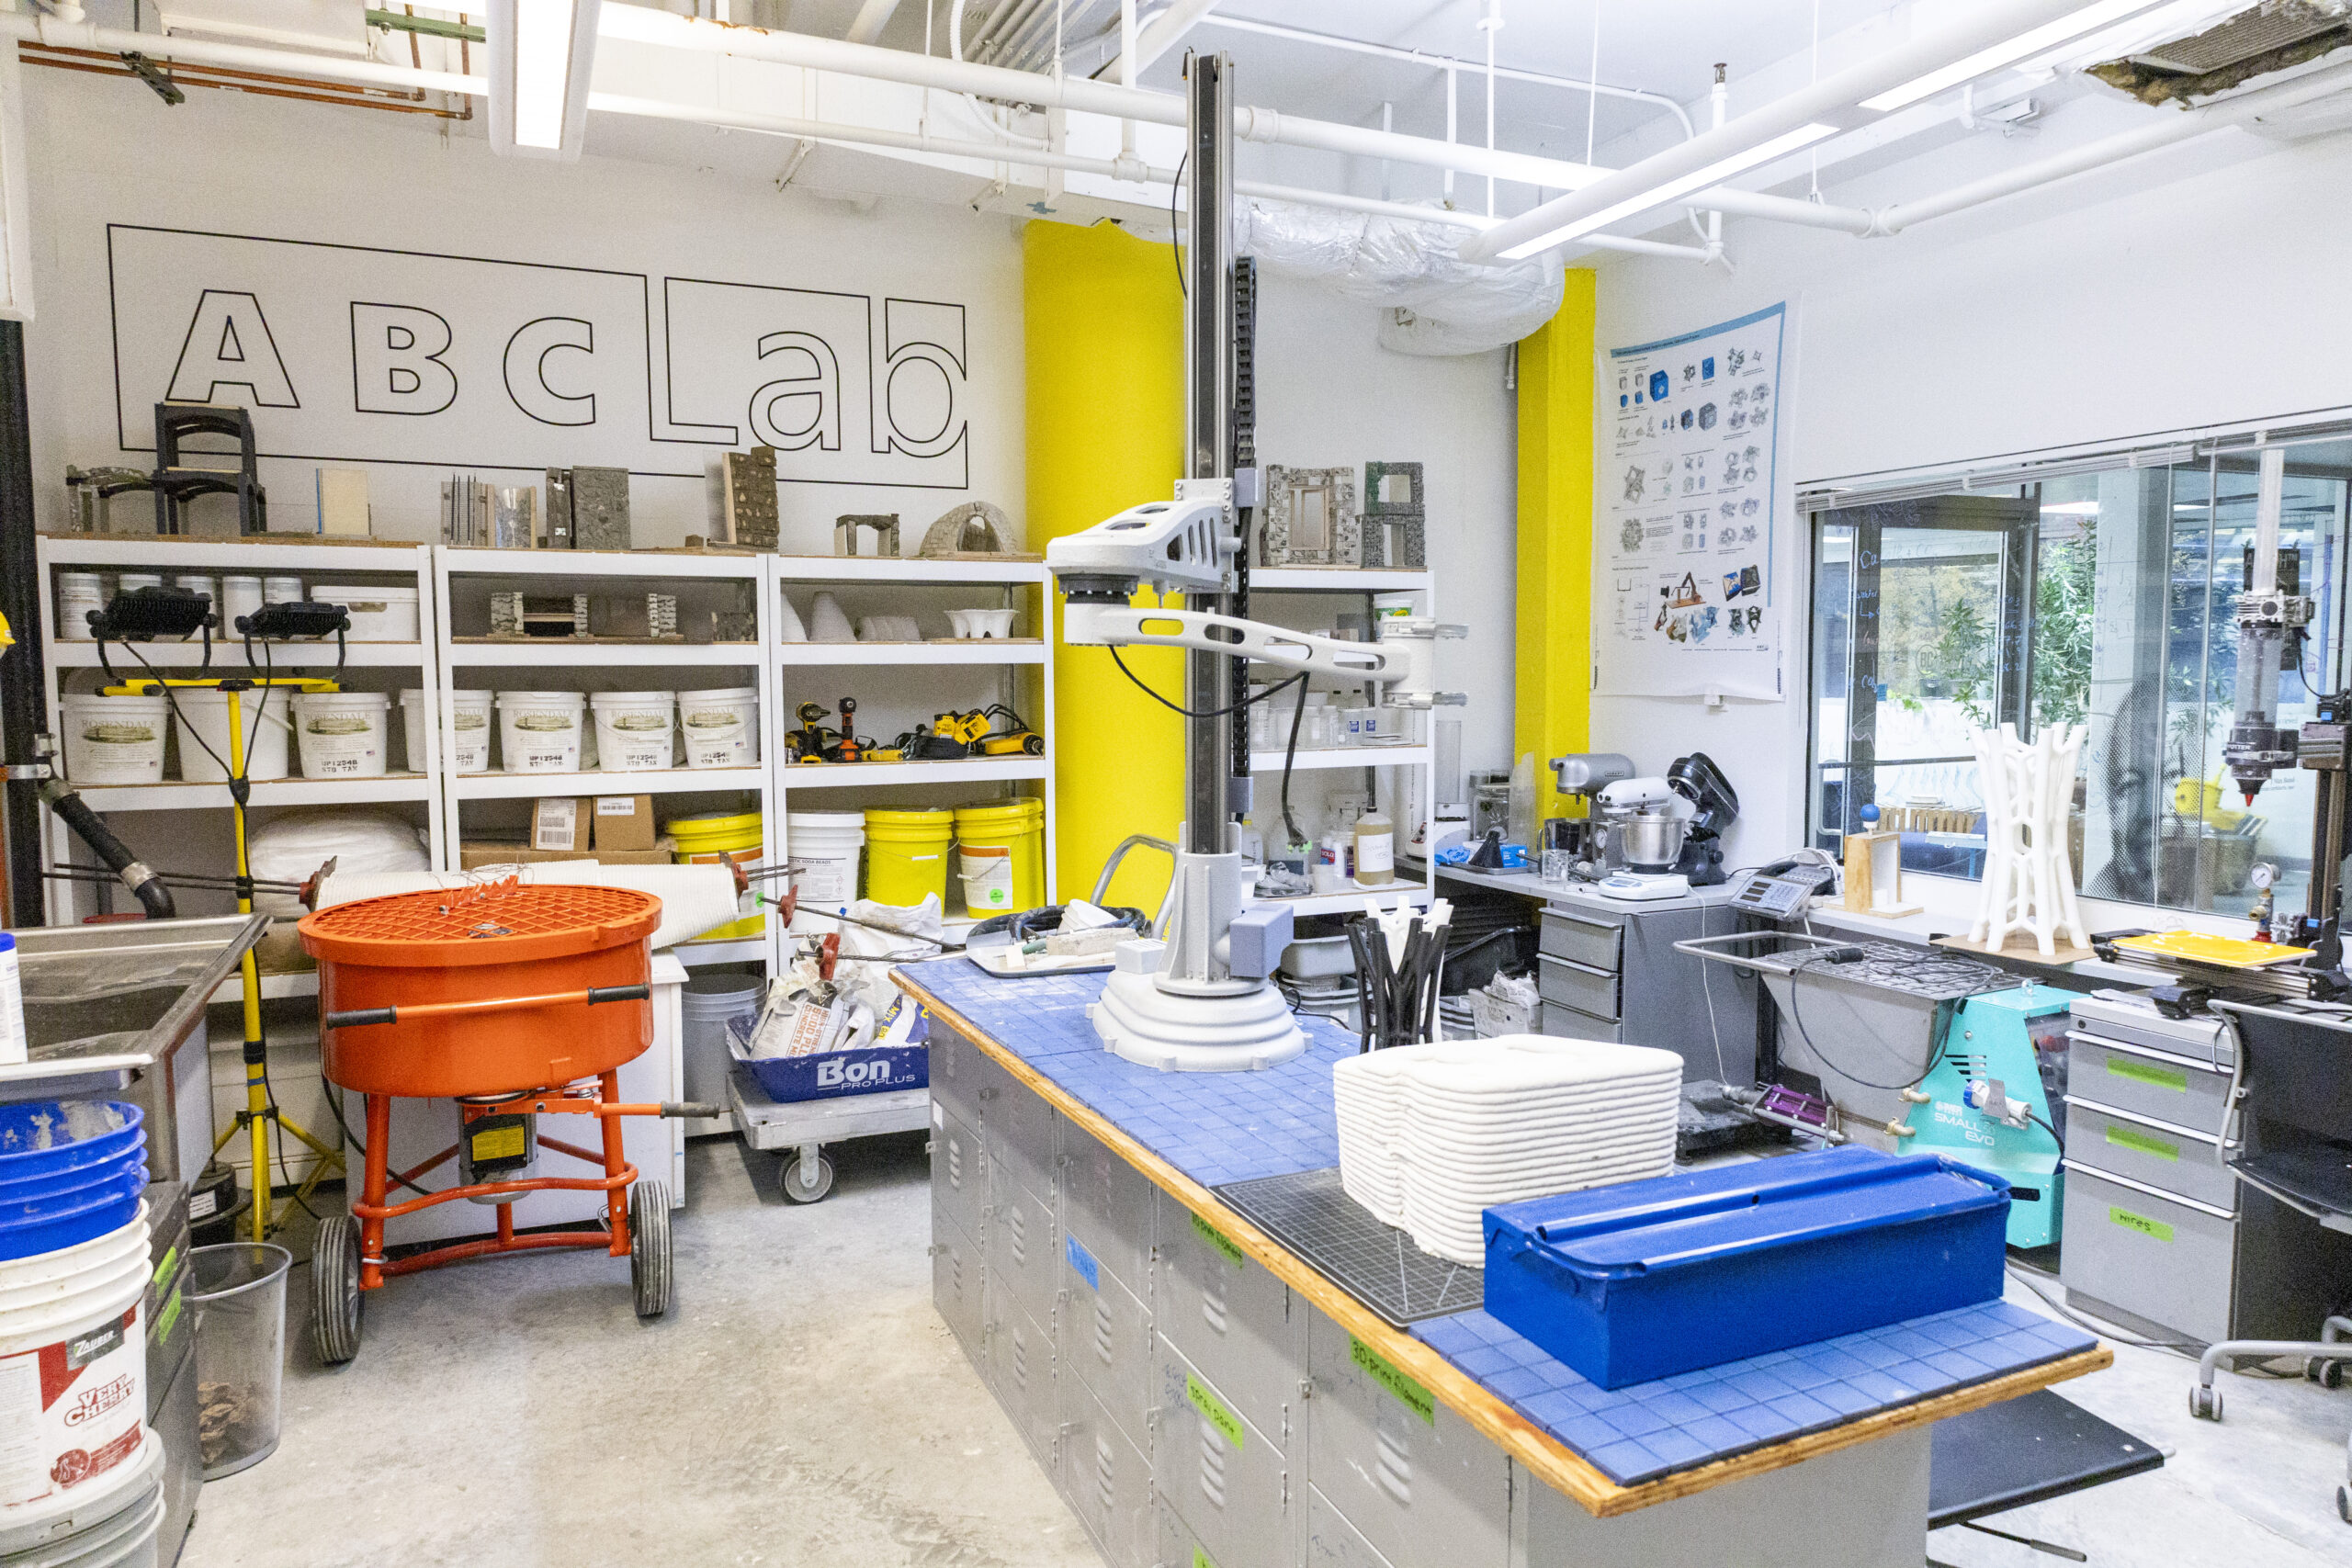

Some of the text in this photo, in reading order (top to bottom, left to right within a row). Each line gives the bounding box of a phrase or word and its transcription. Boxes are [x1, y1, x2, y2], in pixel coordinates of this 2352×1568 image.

[82, 719, 156, 728] ROSENDALE
[806, 1007, 822, 1035] 5000
[817, 1059, 891, 1087] Bon
[841, 1074, 916, 1090] PRO PLUS
[1934, 1111, 1983, 1133] SMALL
[1965, 1130, 1995, 1146] EVO
[1352, 1340, 1367, 1364] 3D
[78, 1373, 127, 1407] VERY
[64, 1378, 136, 1427] CHERRY
